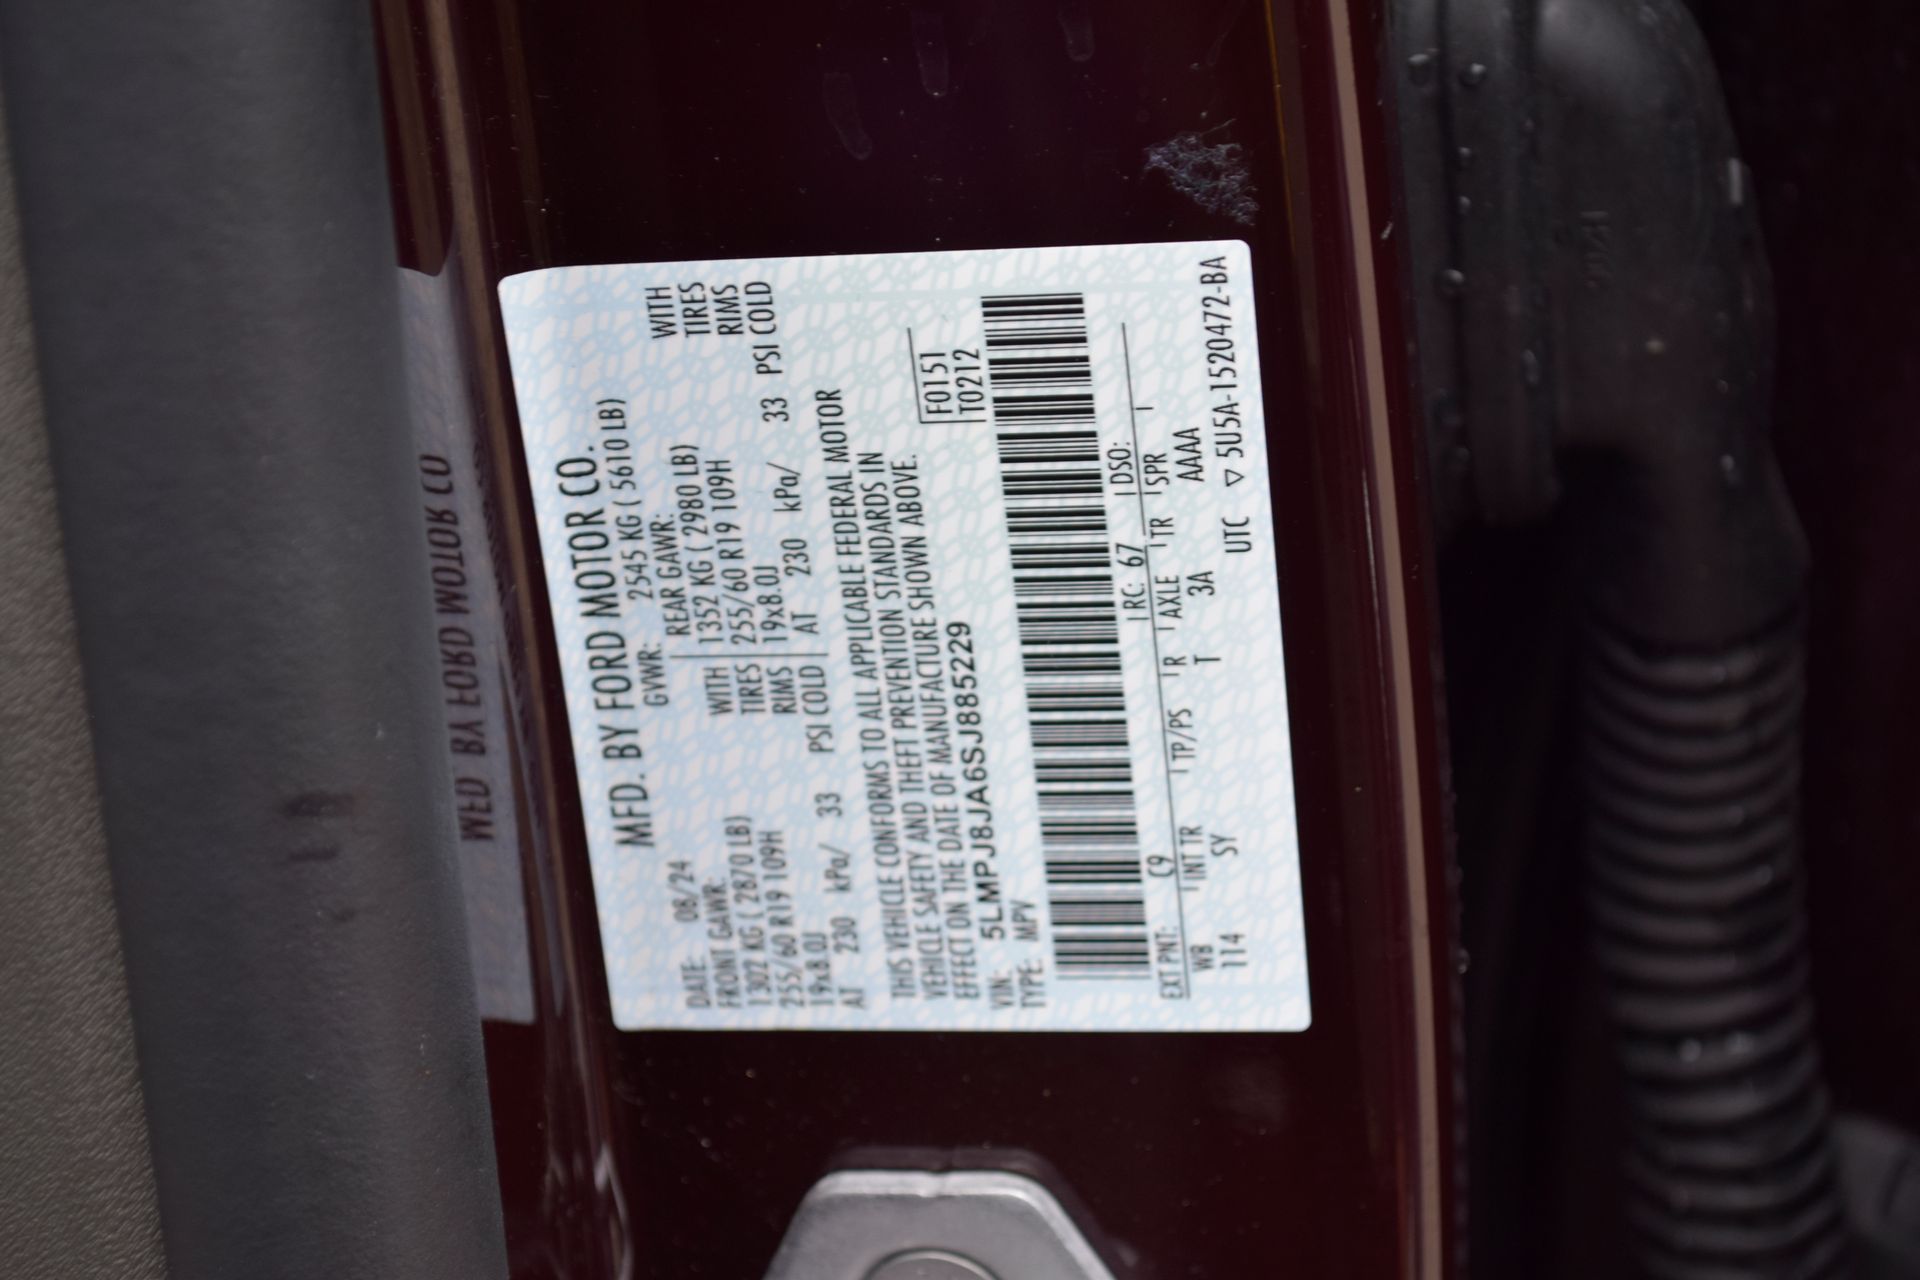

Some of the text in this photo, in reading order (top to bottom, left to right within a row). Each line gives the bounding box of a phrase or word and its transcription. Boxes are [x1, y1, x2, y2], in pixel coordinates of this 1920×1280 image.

[644, 286, 679, 340] WITH
[676, 281, 712, 339] TIRES
[709, 283, 745, 337] RIMS
[918, 351, 955, 415] F0151
[950, 348, 987, 416] T0212
[1198, 255, 1253, 555] UTC 5U5A-1520472-BA
[595, 397, 628, 432] LB)
[601, 437, 638, 491] 5610
[668, 443, 701, 478] LB)
[743, 280, 820, 636] AT 230 kPa/ 33 PSI COLD
[1105, 440, 1136, 486] DSO:
[1141, 452, 1171, 487] SPR
[1171, 426, 1206, 483] AAAA
[614, 513, 645, 542] KG
[674, 483, 710, 538] 2980
[1148, 516, 1176, 540] TR
[620, 549, 656, 601] 2545
[647, 512, 692, 637] REAR GAWR:
[685, 559, 717, 587] KG
[704, 459, 758, 646] 255/60 R19 109H
[1114, 542, 1148, 611] RC: 67
[751, 564, 789, 645] 19x8.0J
[1153, 575, 1184, 620] AXLE
[1185, 570, 1216, 598] 3A
[554, 444, 656, 848] MFD. BY FORD MOTOR CO.
[690, 594, 726, 645] 1352
[635, 642, 671, 708] GVWR:
[1161, 655, 1188, 668] R
[1192, 654, 1222, 666] T
[703, 666, 734, 717] WITH
[733, 662, 766, 716] TIRES
[765, 665, 798, 716] RIMS
[813, 388, 916, 999] THIS VEHICLE CONFORMS TO ALL APPLICABLE FEDERAL MOTOR
[856, 451, 950, 1000] VEHICLE SAFETY AND THEFT PREVENTION STANDARDS IN
[889, 452, 982, 1000] EFFECT ON THE DATE OF MANUFACTURE SHOWN ABOVE.
[1166, 707, 1198, 763] TP/PS
[723, 815, 753, 847] LB)
[796, 664, 865, 1009] AT 230 kPa/ 33 PSI COLD
[944, 620, 1015, 1009] VIN: 5LMPJ8JA6SJ885229
[1177, 825, 1207, 881] INT TR
[1208, 832, 1240, 858] SY
[727, 855, 762, 905] 2870
[667, 859, 712, 1009] DATE: 08/24
[700, 875, 741, 1009] FRONT GAWR:
[737, 926, 766, 952] KG
[758, 830, 806, 1009] 255/60 R19 109H
[1145, 854, 1185, 1000] EXT PNT: C9
[801, 931, 834, 1006] 19x8.0J
[1009, 899, 1046, 1010] TYPE: MPV
[1188, 944, 1215, 973] WB
[1218, 932, 1248, 970] 114
[741, 958, 774, 1007] 1302
